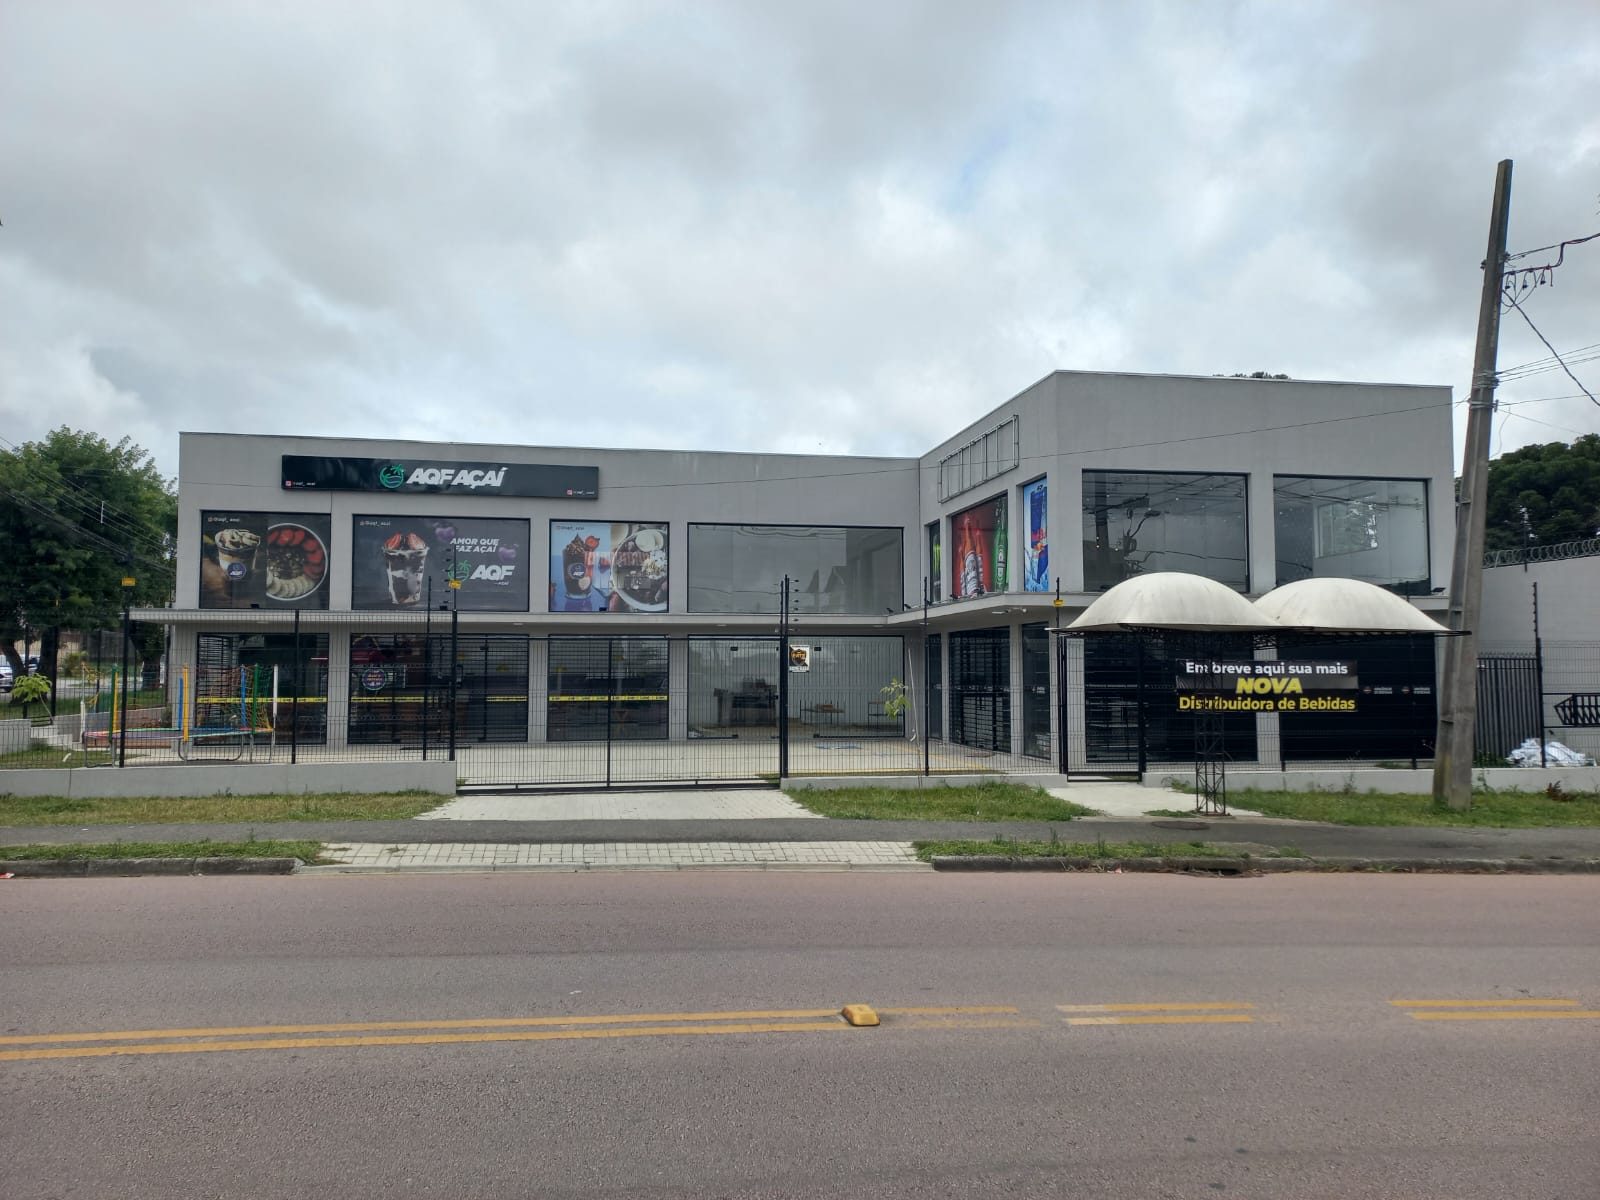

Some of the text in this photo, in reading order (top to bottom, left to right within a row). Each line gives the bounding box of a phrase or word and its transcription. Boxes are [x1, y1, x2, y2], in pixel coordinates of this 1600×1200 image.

[406, 466, 508, 489] AQF AÇAÍ
[450, 537, 500, 546] AMOR QUE
[469, 564, 515, 581] AQF
[1186, 662, 1348, 676] Em breve aqui sua mais
[1235, 677, 1303, 694] NOVA
[1179, 696, 1356, 710] Distribuidora de Bebidas
